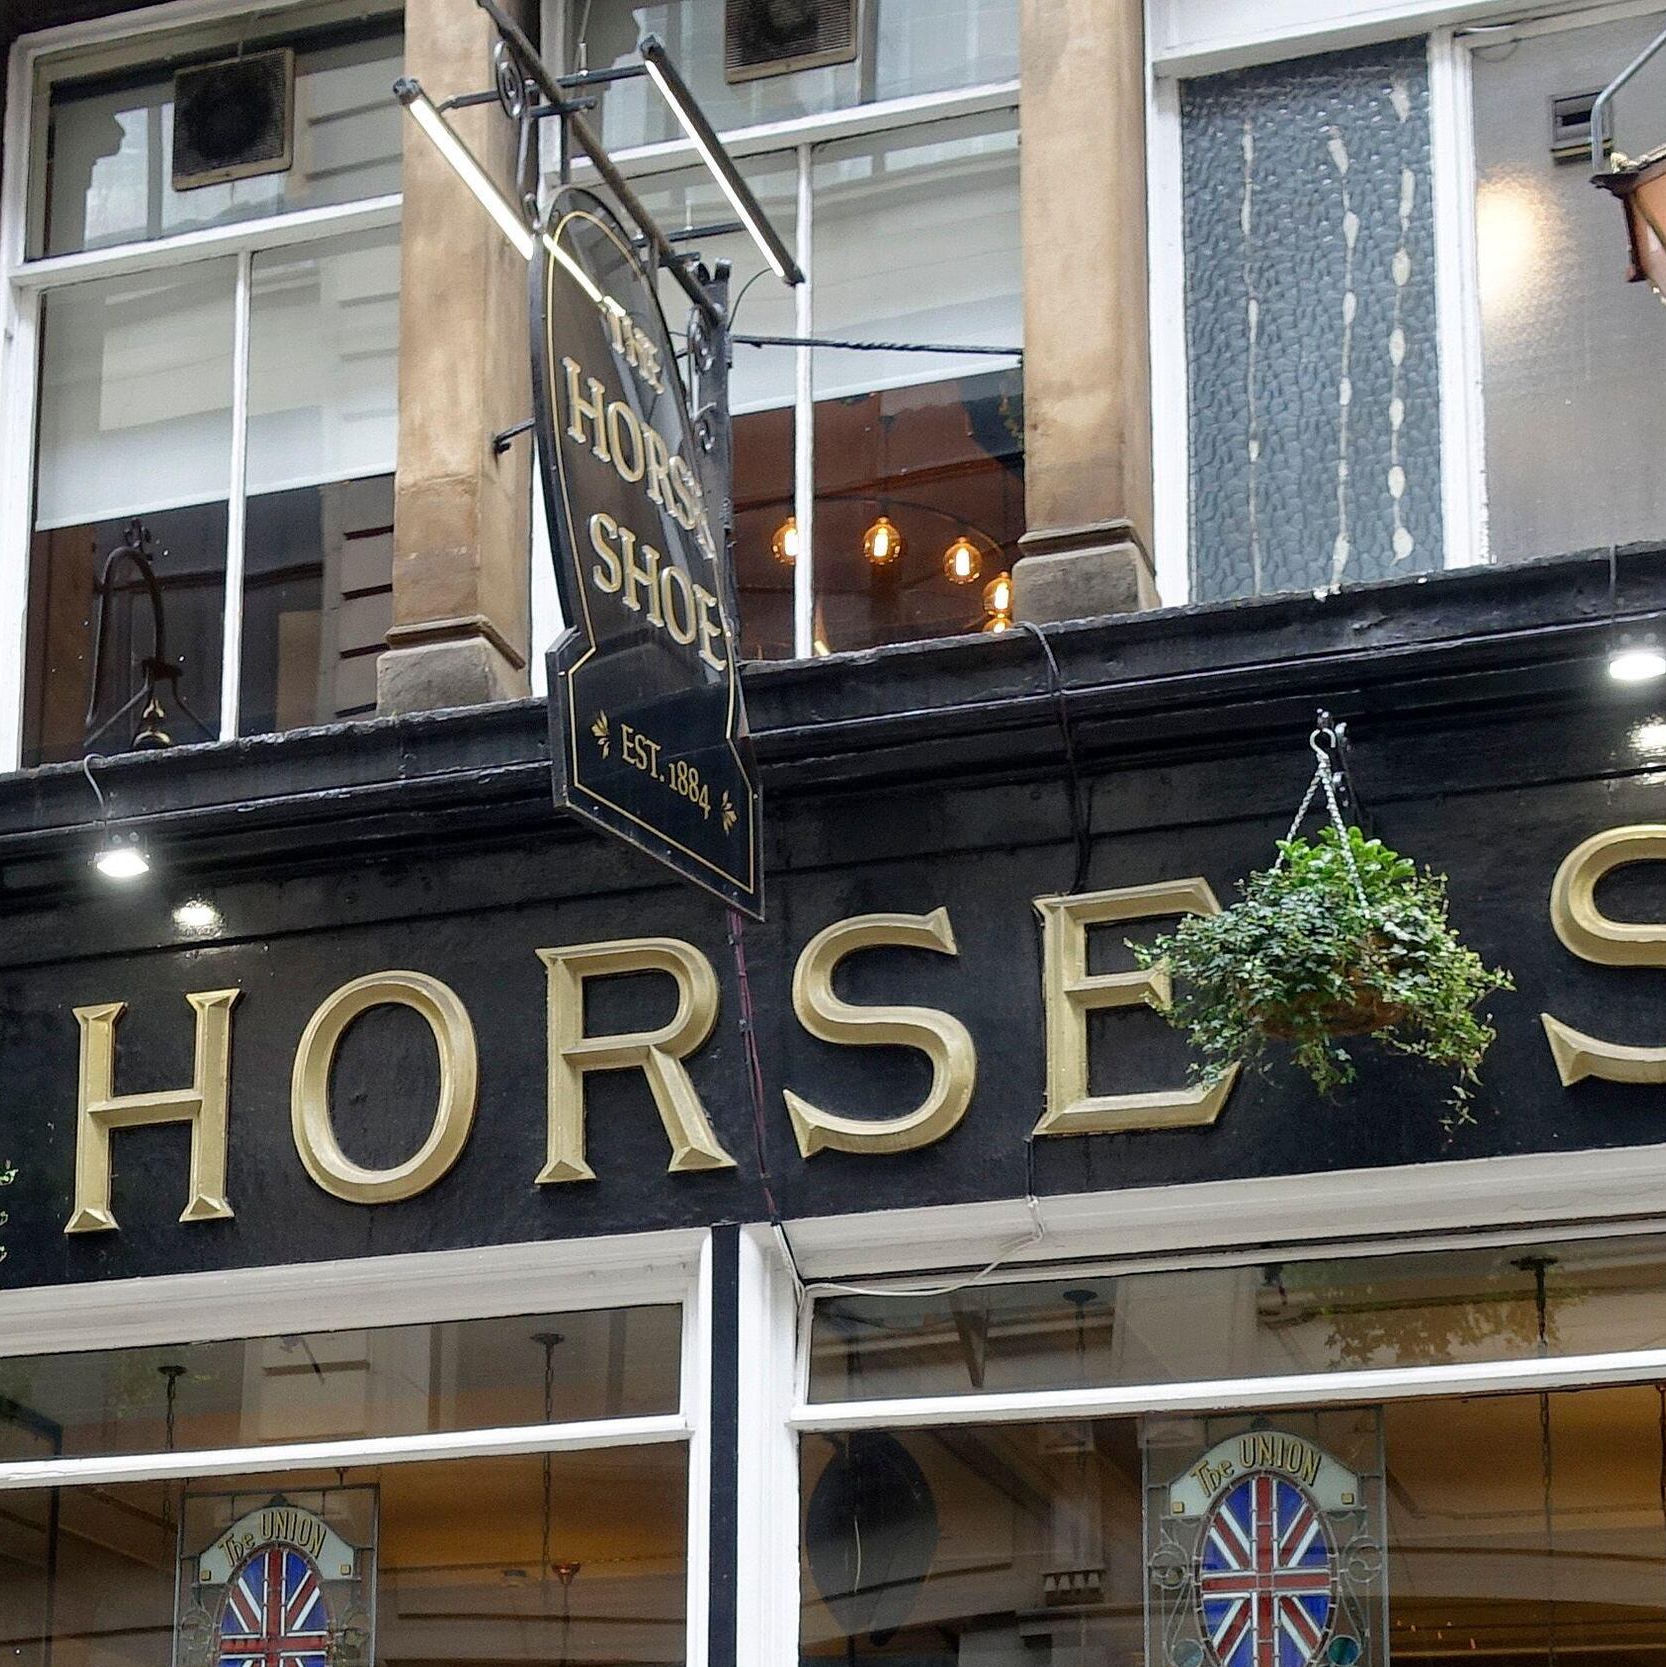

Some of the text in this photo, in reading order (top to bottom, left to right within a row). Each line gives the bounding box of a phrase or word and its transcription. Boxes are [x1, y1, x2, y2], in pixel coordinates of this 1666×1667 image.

[590, 513, 727, 671] SHOE
[620, 723, 711, 820] EST. 1884
[64, 876, 1241, 1236] HORSE
[1189, 1435, 1322, 1498] The UNION
[217, 1511, 327, 1567] The UNION
